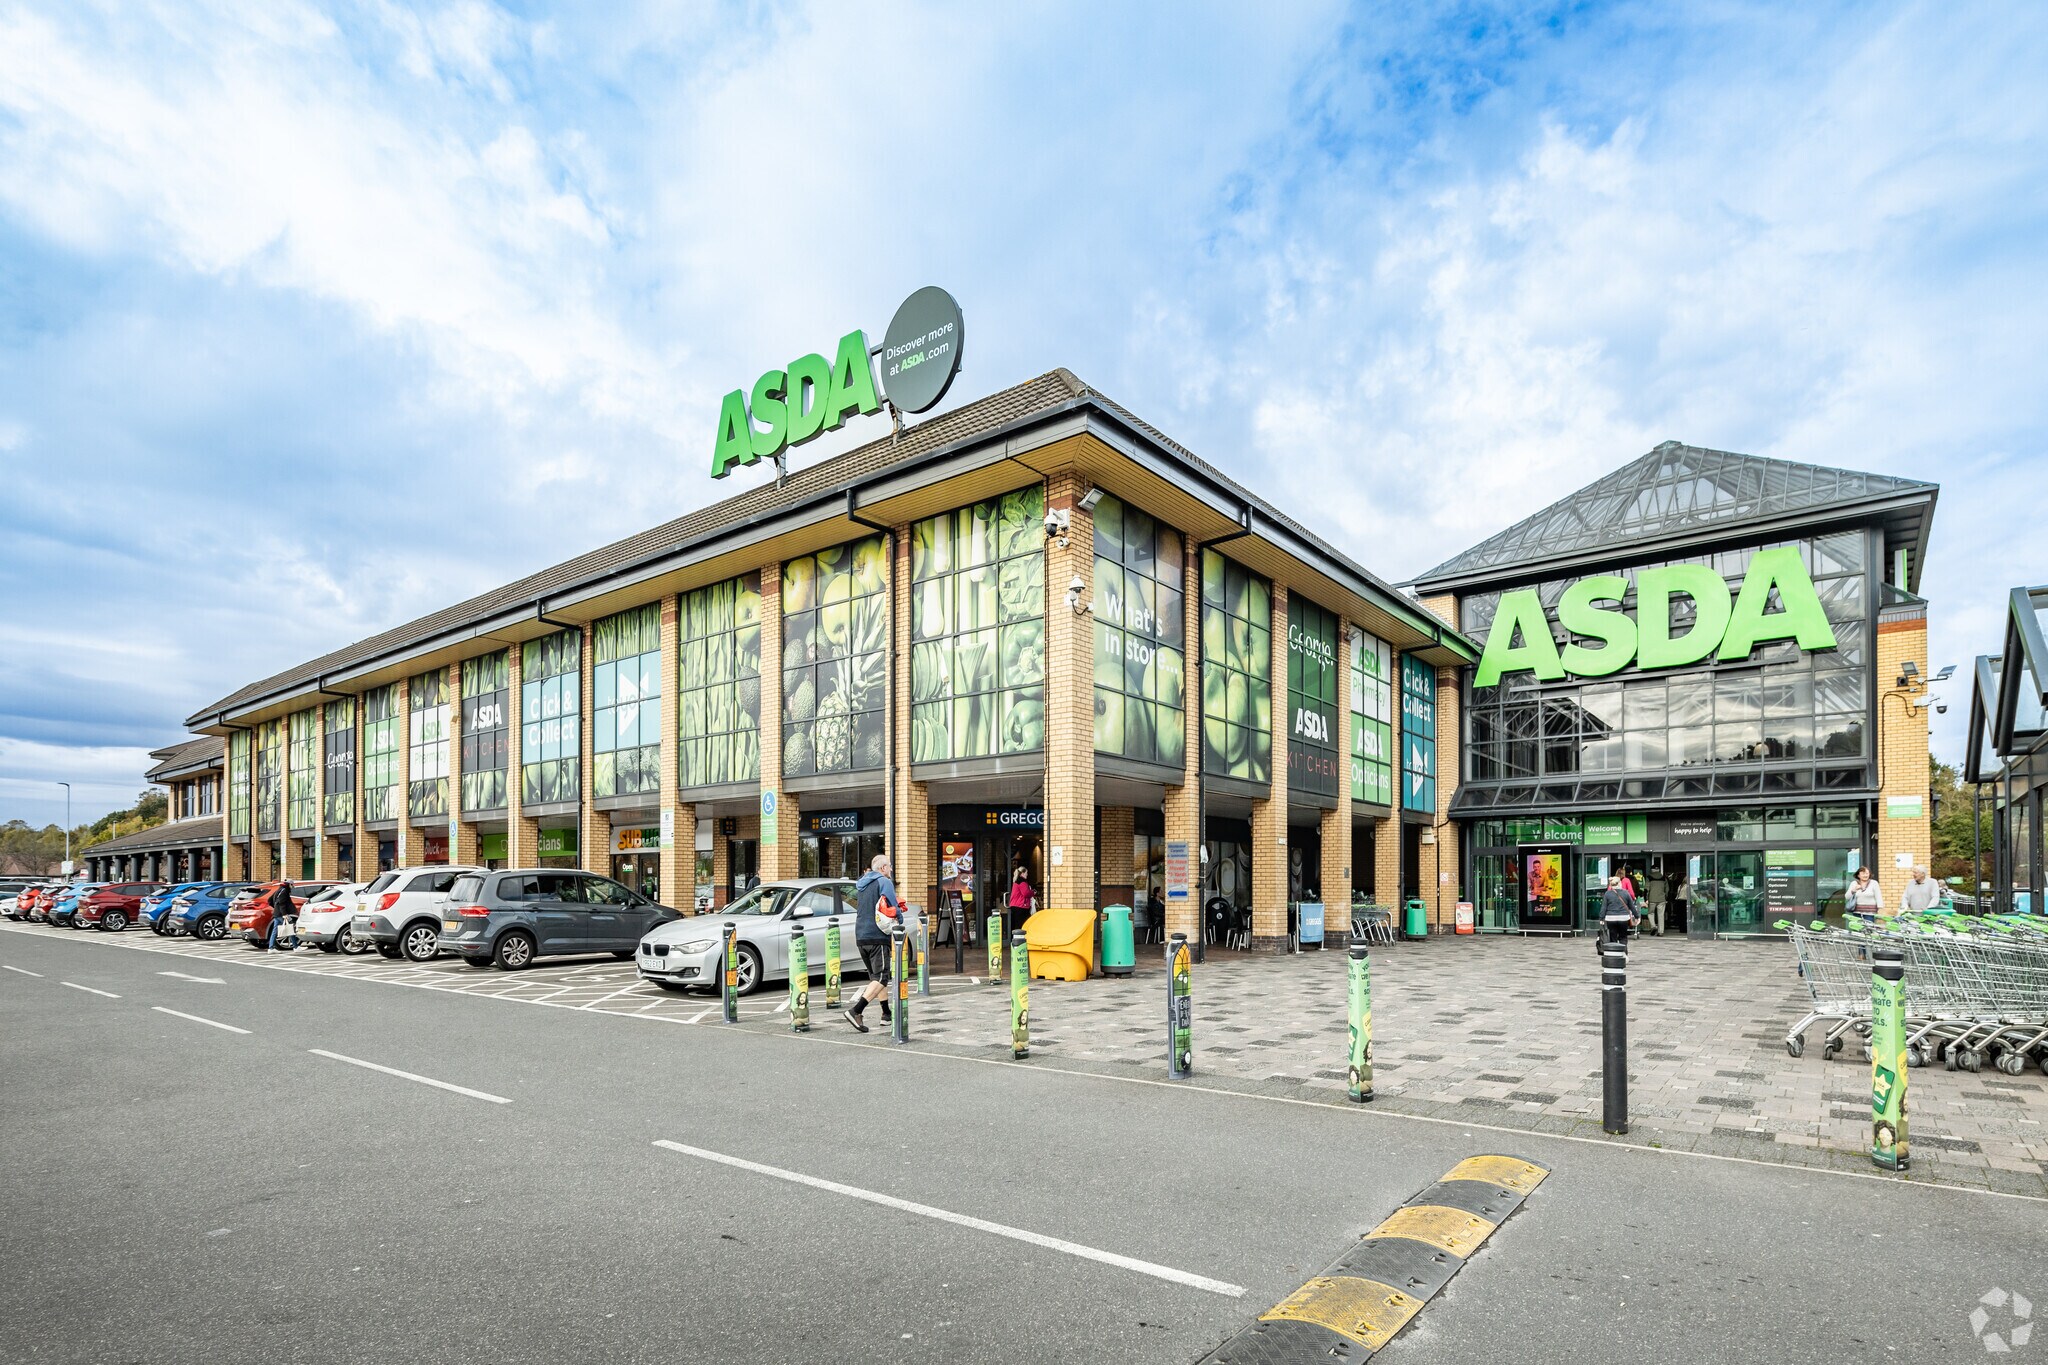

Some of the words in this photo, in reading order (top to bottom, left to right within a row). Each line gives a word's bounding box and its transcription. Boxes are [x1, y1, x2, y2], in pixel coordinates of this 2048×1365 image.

[886, 335, 926, 360] Discover
[928, 322, 953, 341] more
[890, 363, 900, 376] at
[711, 329, 880, 478] ASDA
[1104, 590, 1163, 637] What's
[1473, 545, 1837, 688] ASDA
[1105, 626, 1120, 656] in
[1126, 637, 1178, 674] store...
[1357, 646, 1382, 677] ASDA
[1403, 667, 1424, 695] Cick
[1424, 677, 1430, 697] &
[471, 703, 502, 731] ASDA
[531, 692, 561, 719] Cick
[564, 690, 573, 712] &
[1403, 693, 1431, 723] Collect
[420, 721, 442, 742] ASDA
[529, 719, 575, 746] Collect
[1295, 708, 1329, 743] ASDA
[371, 729, 395, 753] ASDA
[462, 738, 509, 760] KICHEN
[1356, 728, 1383, 759] ASDA
[820, 816, 855, 829] GREGGS
[1000, 812, 1045, 825] GREGG
[1674, 827, 1692, 835] happy
[622, 863, 634, 871] Open
